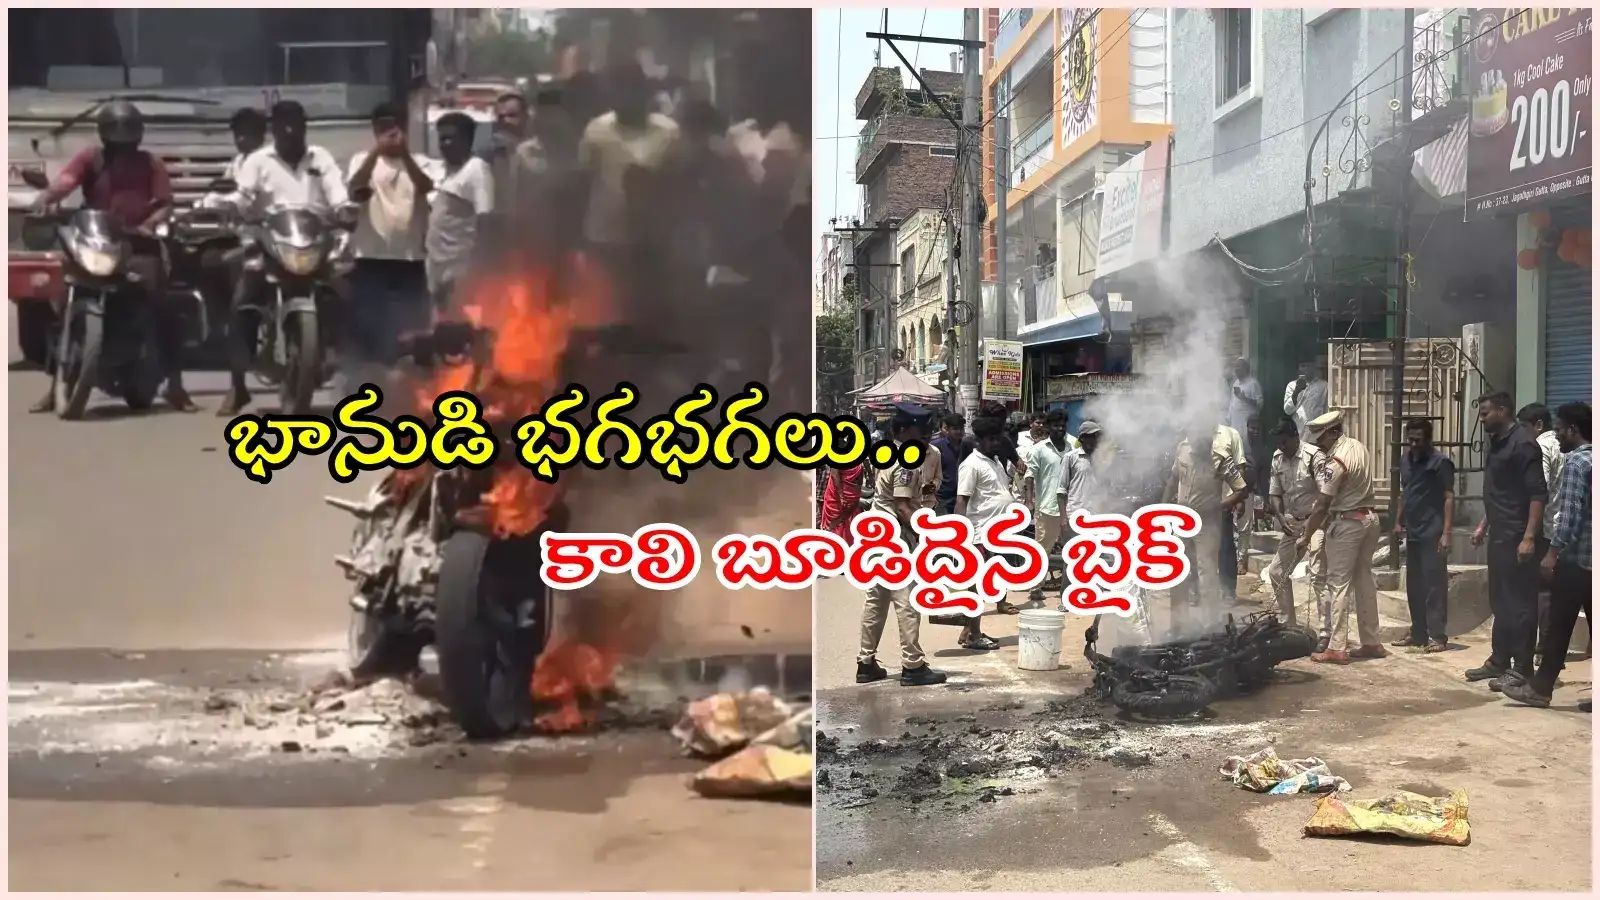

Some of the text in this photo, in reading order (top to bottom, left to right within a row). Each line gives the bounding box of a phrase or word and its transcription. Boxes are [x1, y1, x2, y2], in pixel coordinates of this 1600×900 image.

[1513, 53, 1564, 88] 1kg Cool Cake
[1573, 74, 1591, 96] Only
[1549, 178, 1572, 194] Opposite
[1575, 174, 1590, 186] Gutta
